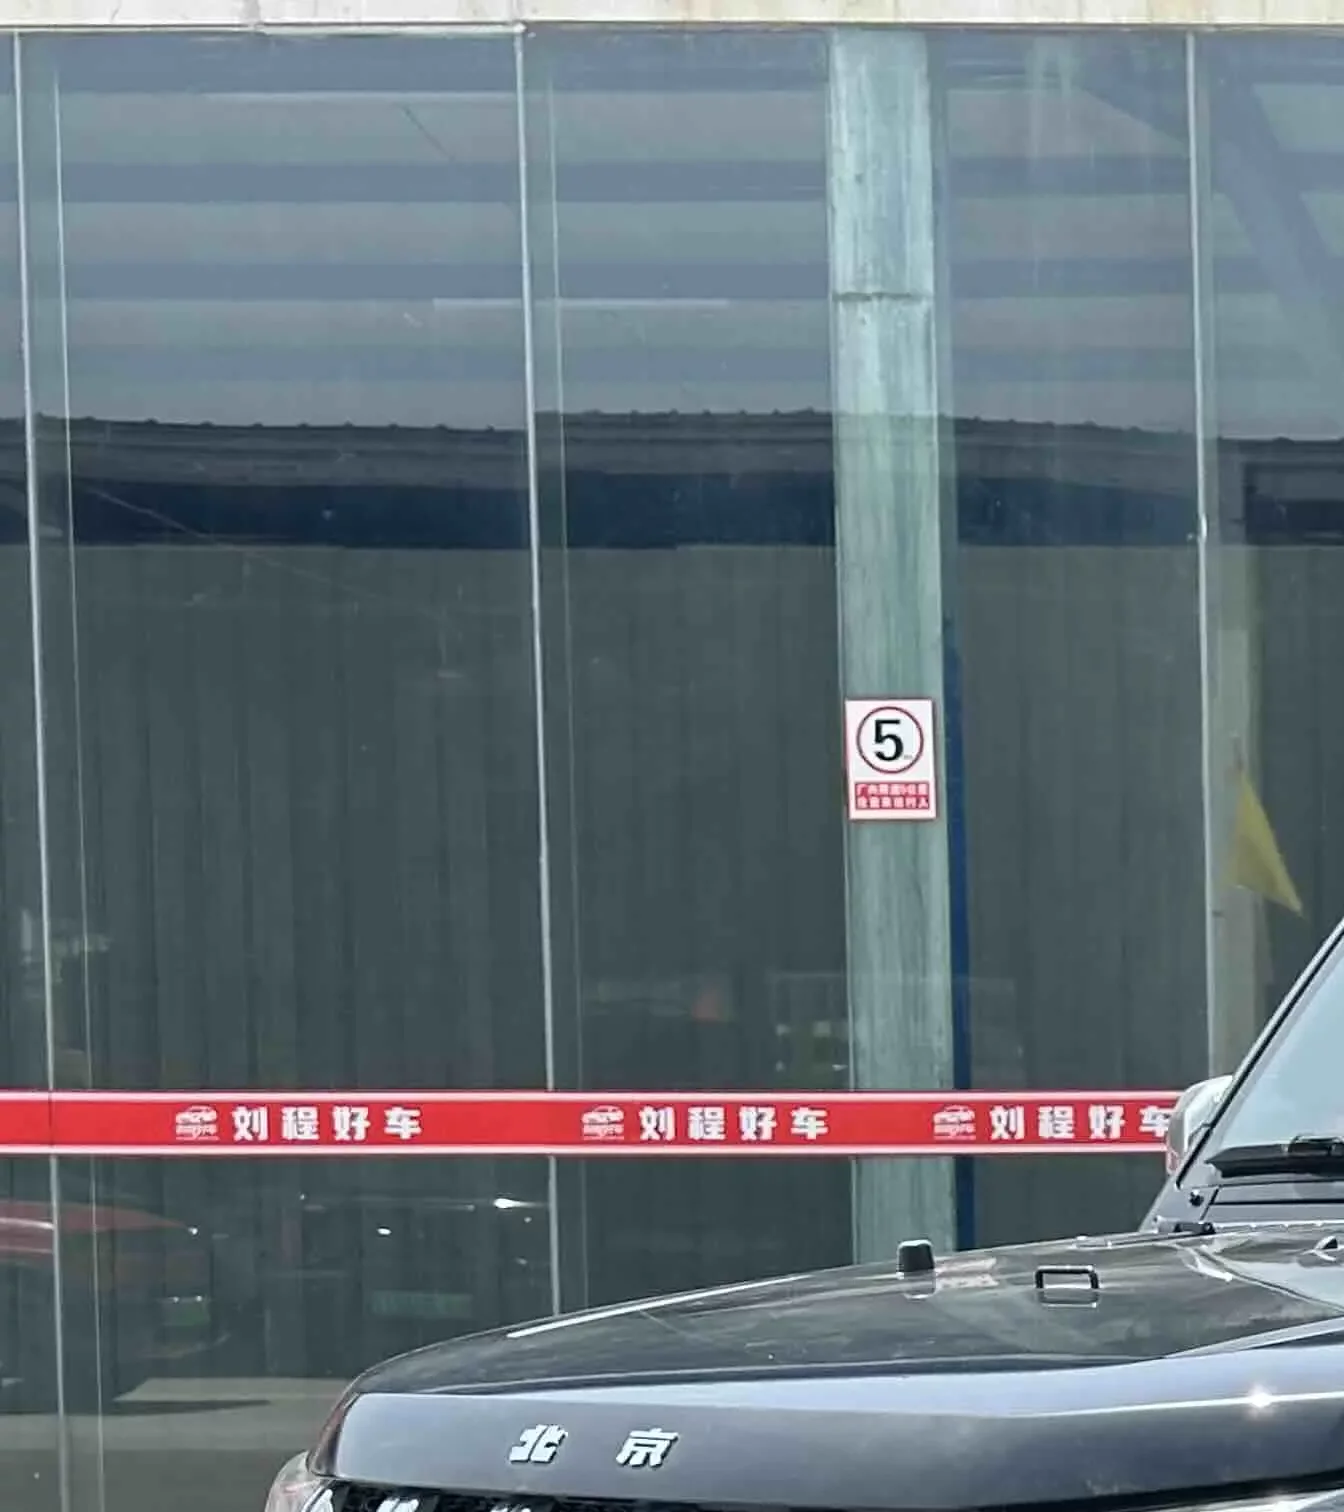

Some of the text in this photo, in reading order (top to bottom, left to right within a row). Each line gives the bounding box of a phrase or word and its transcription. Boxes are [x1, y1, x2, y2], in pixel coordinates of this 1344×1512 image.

[874, 719, 903, 761] 5
[232, 1106, 422, 1140] 刘程好车
[639, 1106, 828, 1140] 刘程好车
[990, 1105, 1174, 1140] 刘程好车
[509, 1424, 679, 1467] 北京
